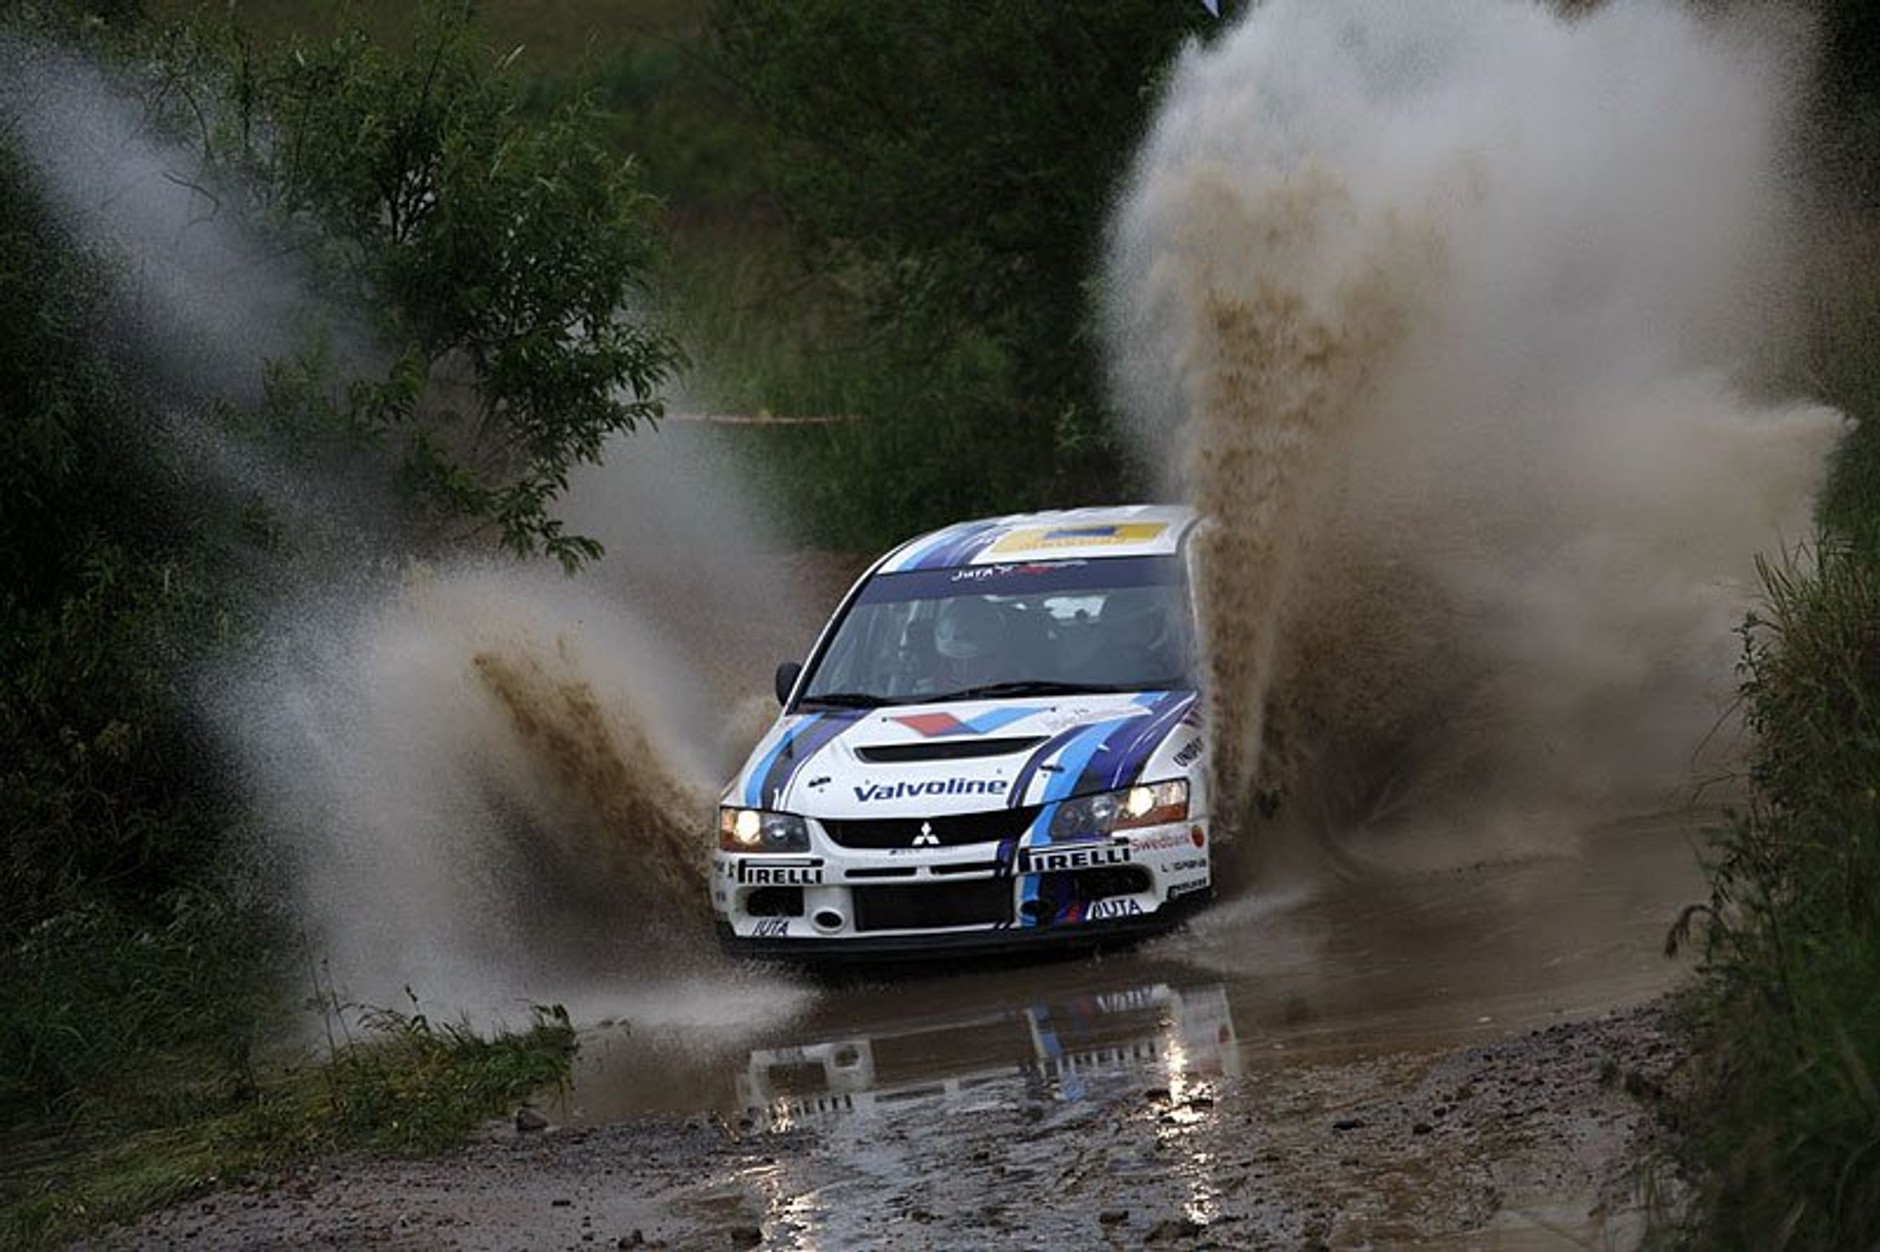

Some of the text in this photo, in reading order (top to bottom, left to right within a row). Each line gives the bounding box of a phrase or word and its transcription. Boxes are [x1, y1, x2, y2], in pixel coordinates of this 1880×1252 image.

[854, 778, 1008, 802] Valvoline
[1019, 837, 1130, 873] PIRELLI
[738, 858, 824, 884] PIRELLI
